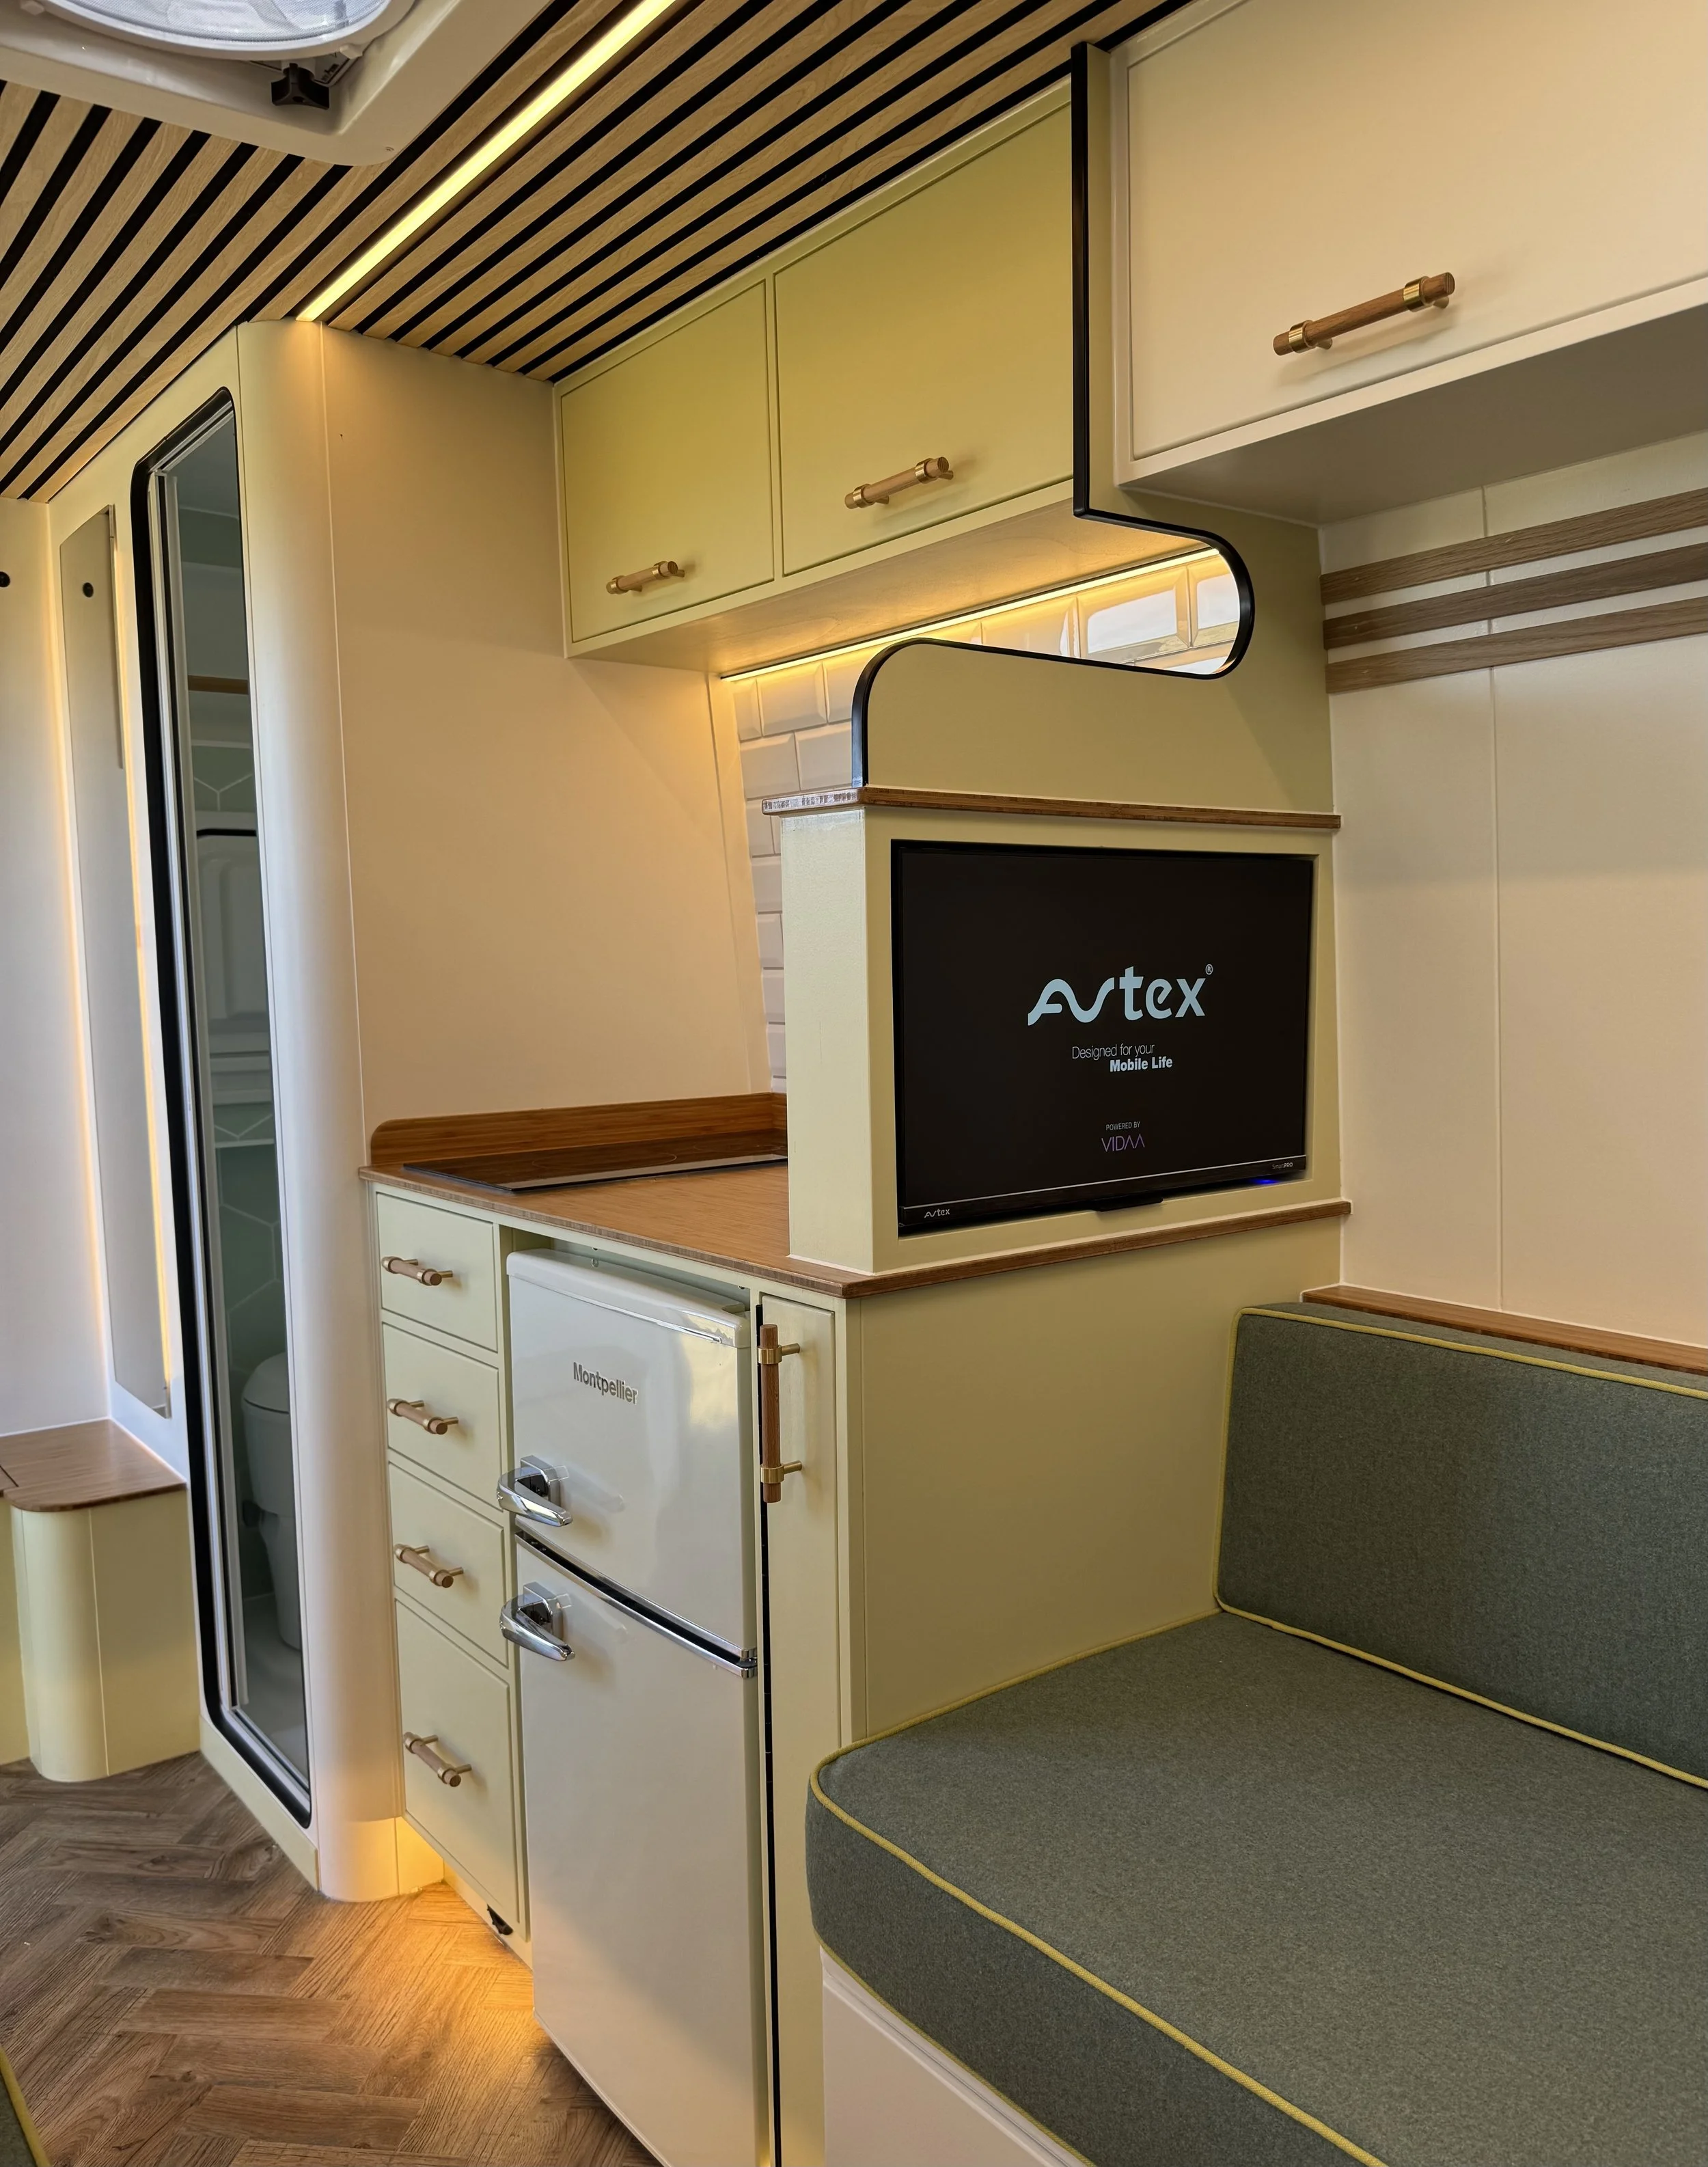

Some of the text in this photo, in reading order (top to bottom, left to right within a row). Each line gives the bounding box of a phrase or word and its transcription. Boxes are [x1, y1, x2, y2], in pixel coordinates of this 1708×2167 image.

[1072, 1043, 1155, 1061] Designed for your
[1110, 1056, 1173, 1072] Mobile Life
[1105, 1121, 1132, 1131] POWERED
[1101, 1134, 1145, 1152] VIDAA
[573, 1361, 638, 1405] Montpellier
